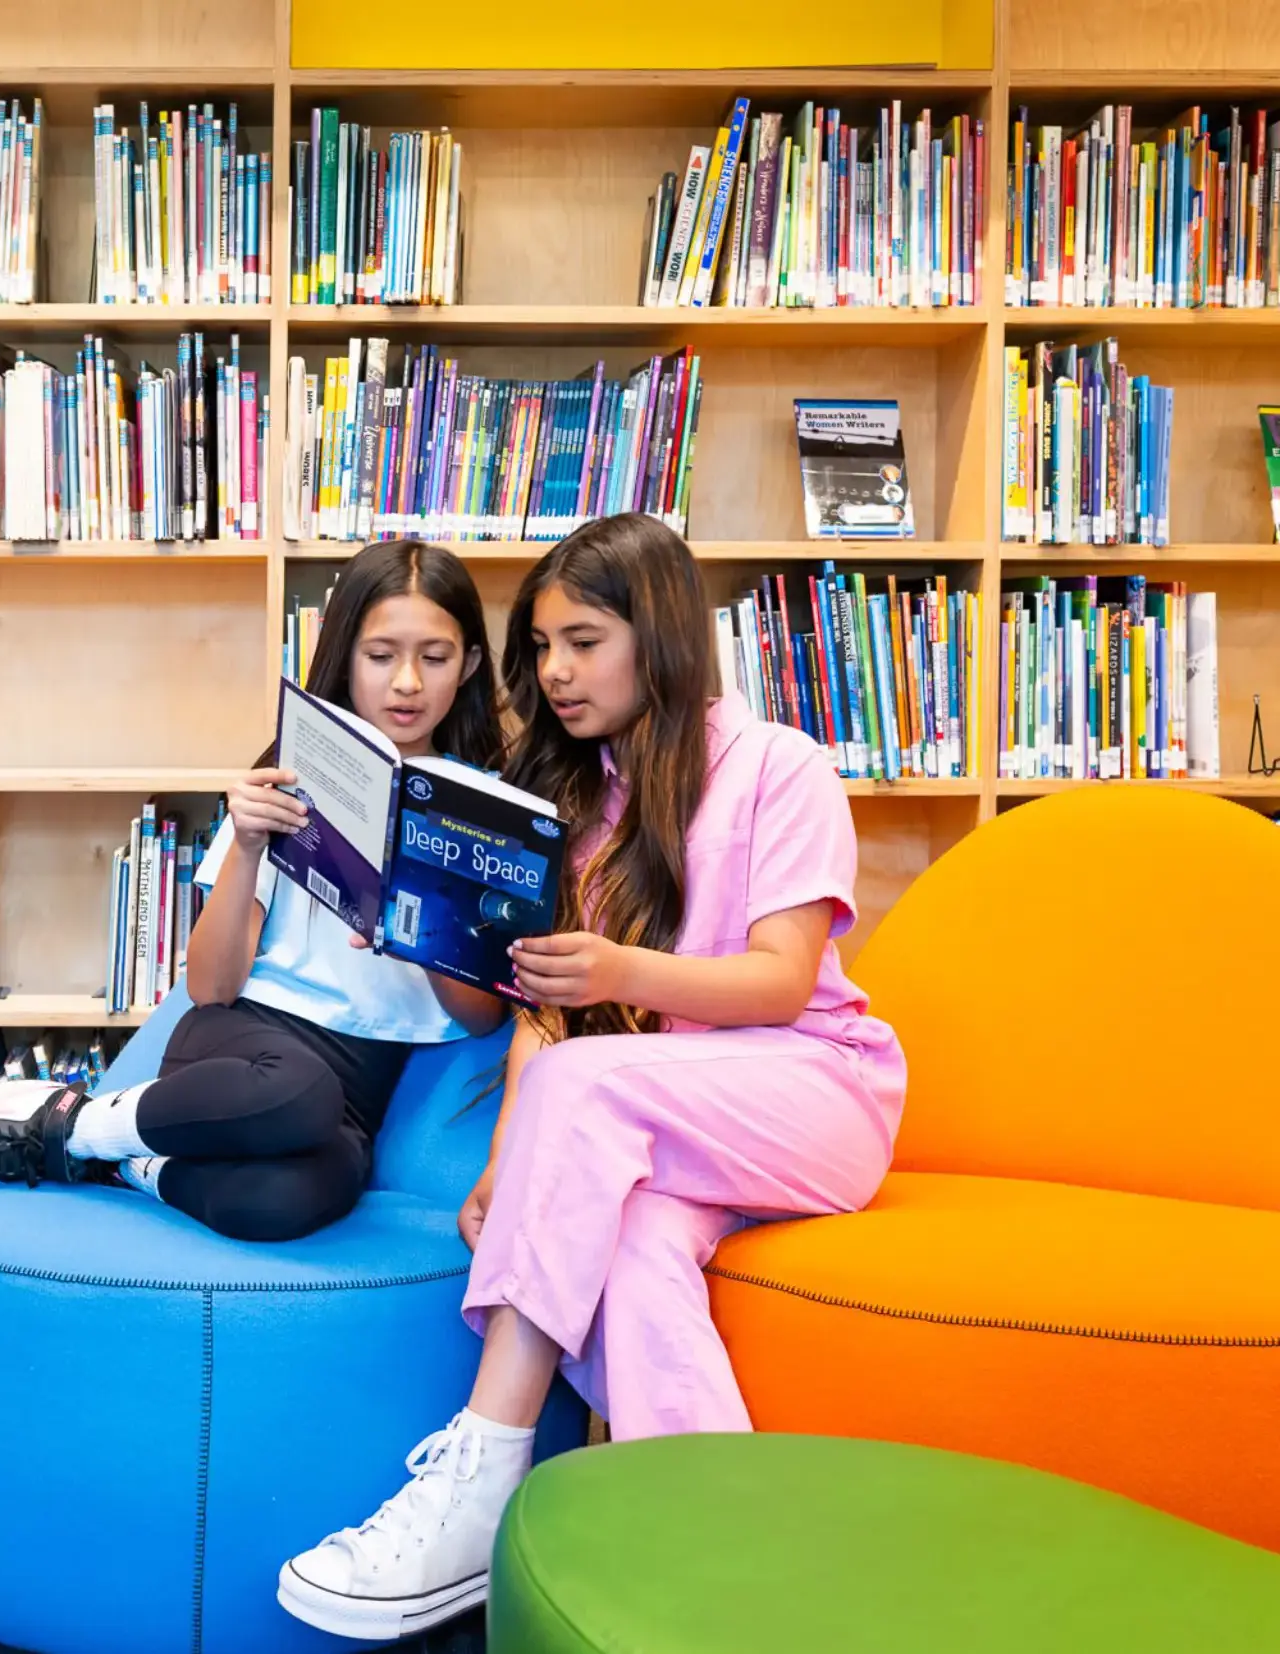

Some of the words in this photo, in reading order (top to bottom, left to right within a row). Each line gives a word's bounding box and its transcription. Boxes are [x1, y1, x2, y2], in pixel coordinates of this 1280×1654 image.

[686, 172, 700, 199] HOW
[676, 202, 694, 249] SCIENCE
[364, 425, 381, 470] Universe
[838, 590, 853, 635] EYEWITNESS
[844, 636, 855, 662] BOOKS
[1109, 632, 1118, 675] LIZARDS
[441, 817, 492, 843] Mysteries
[494, 839, 507, 847] of
[406, 820, 460, 867] Deep
[472, 843, 539, 889] Space
[140, 862, 151, 896] MYTHS
[139, 899, 148, 922] AND
[137, 925, 147, 957] LEGEN
